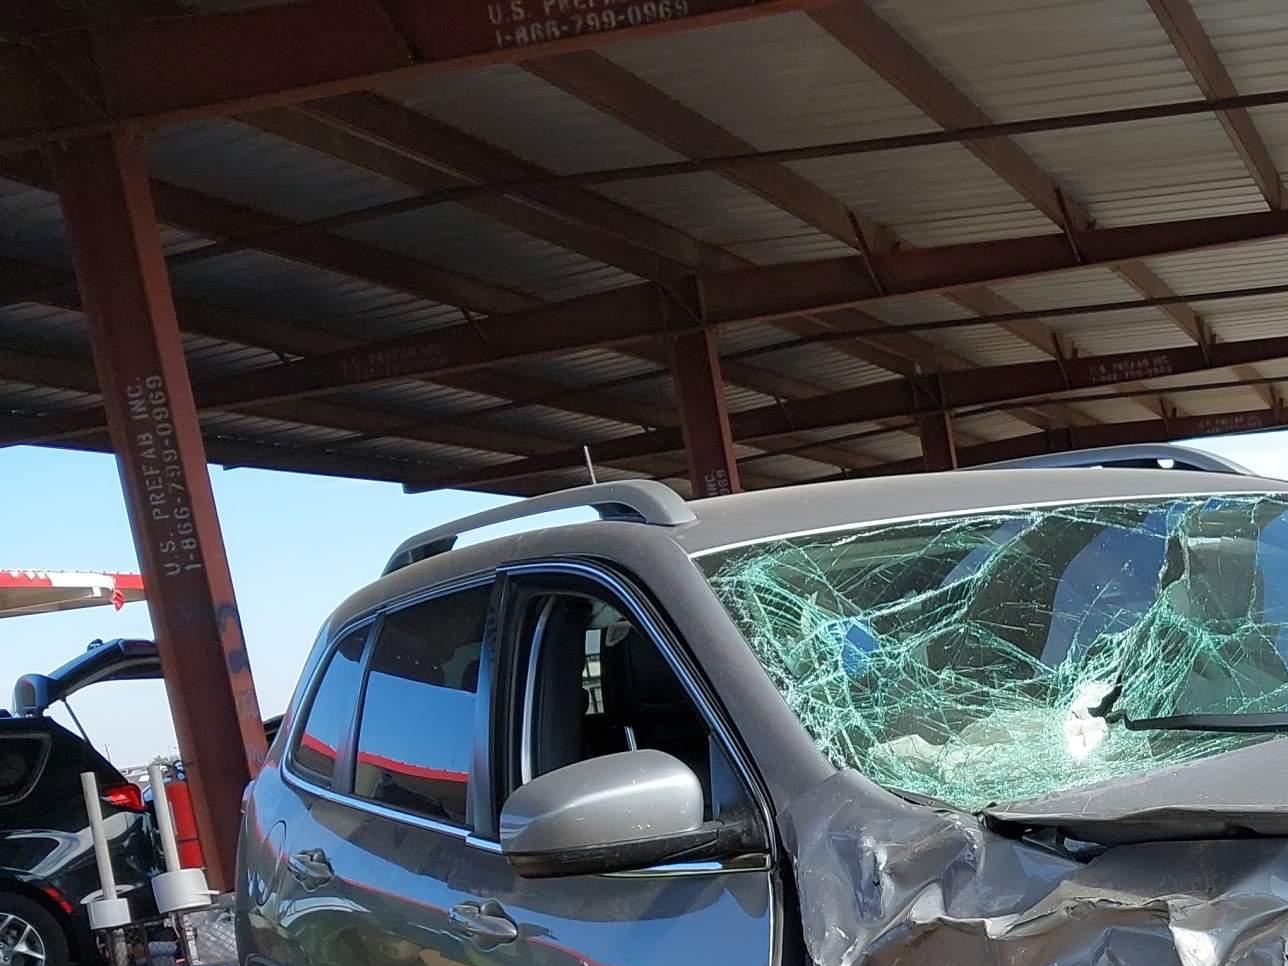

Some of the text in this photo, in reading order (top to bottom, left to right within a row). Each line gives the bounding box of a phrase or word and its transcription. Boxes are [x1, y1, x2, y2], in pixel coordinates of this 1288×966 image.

[126, 376, 149, 420] INC.
[136, 432, 170, 521] PREFAB
[145, 375, 203, 571] 1-866-799-0969
